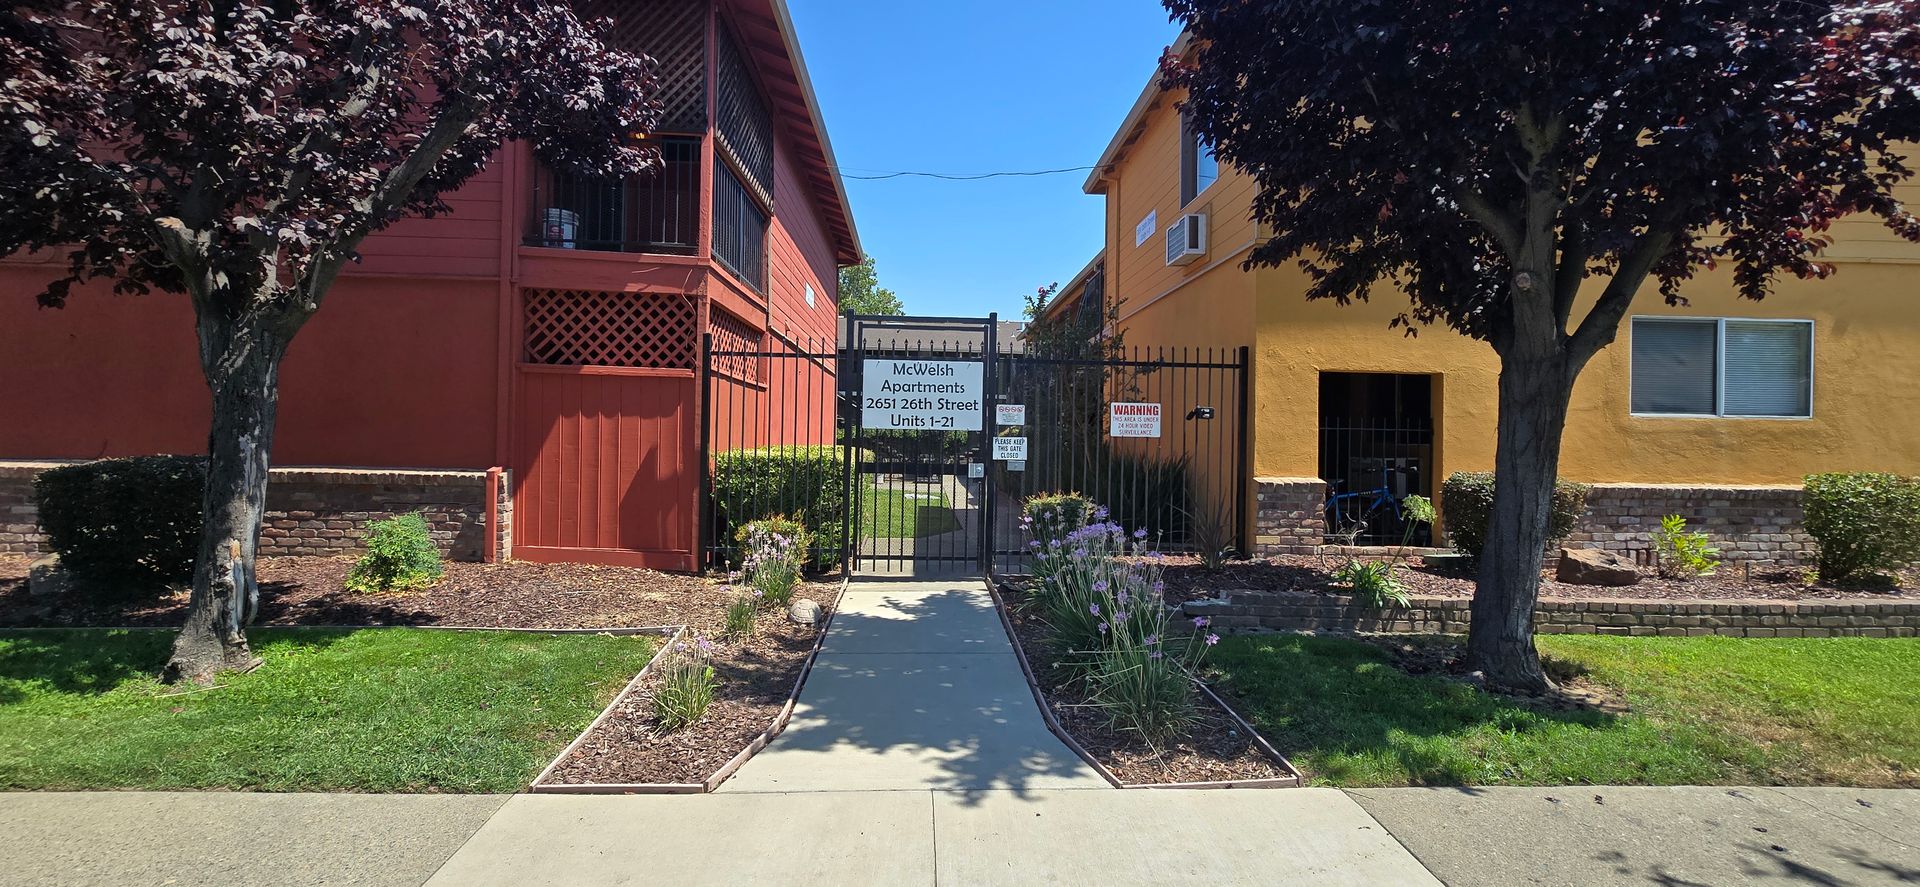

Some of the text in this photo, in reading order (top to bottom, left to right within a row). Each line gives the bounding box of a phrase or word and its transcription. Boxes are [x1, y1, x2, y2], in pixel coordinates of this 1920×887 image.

[893, 362, 954, 376] McWelsh
[881, 380, 965, 394] Apartments
[866, 398, 979, 410] 2651 26th Street
[1114, 405, 1159, 415] WARNING
[891, 414, 954, 427] Units 1-21
